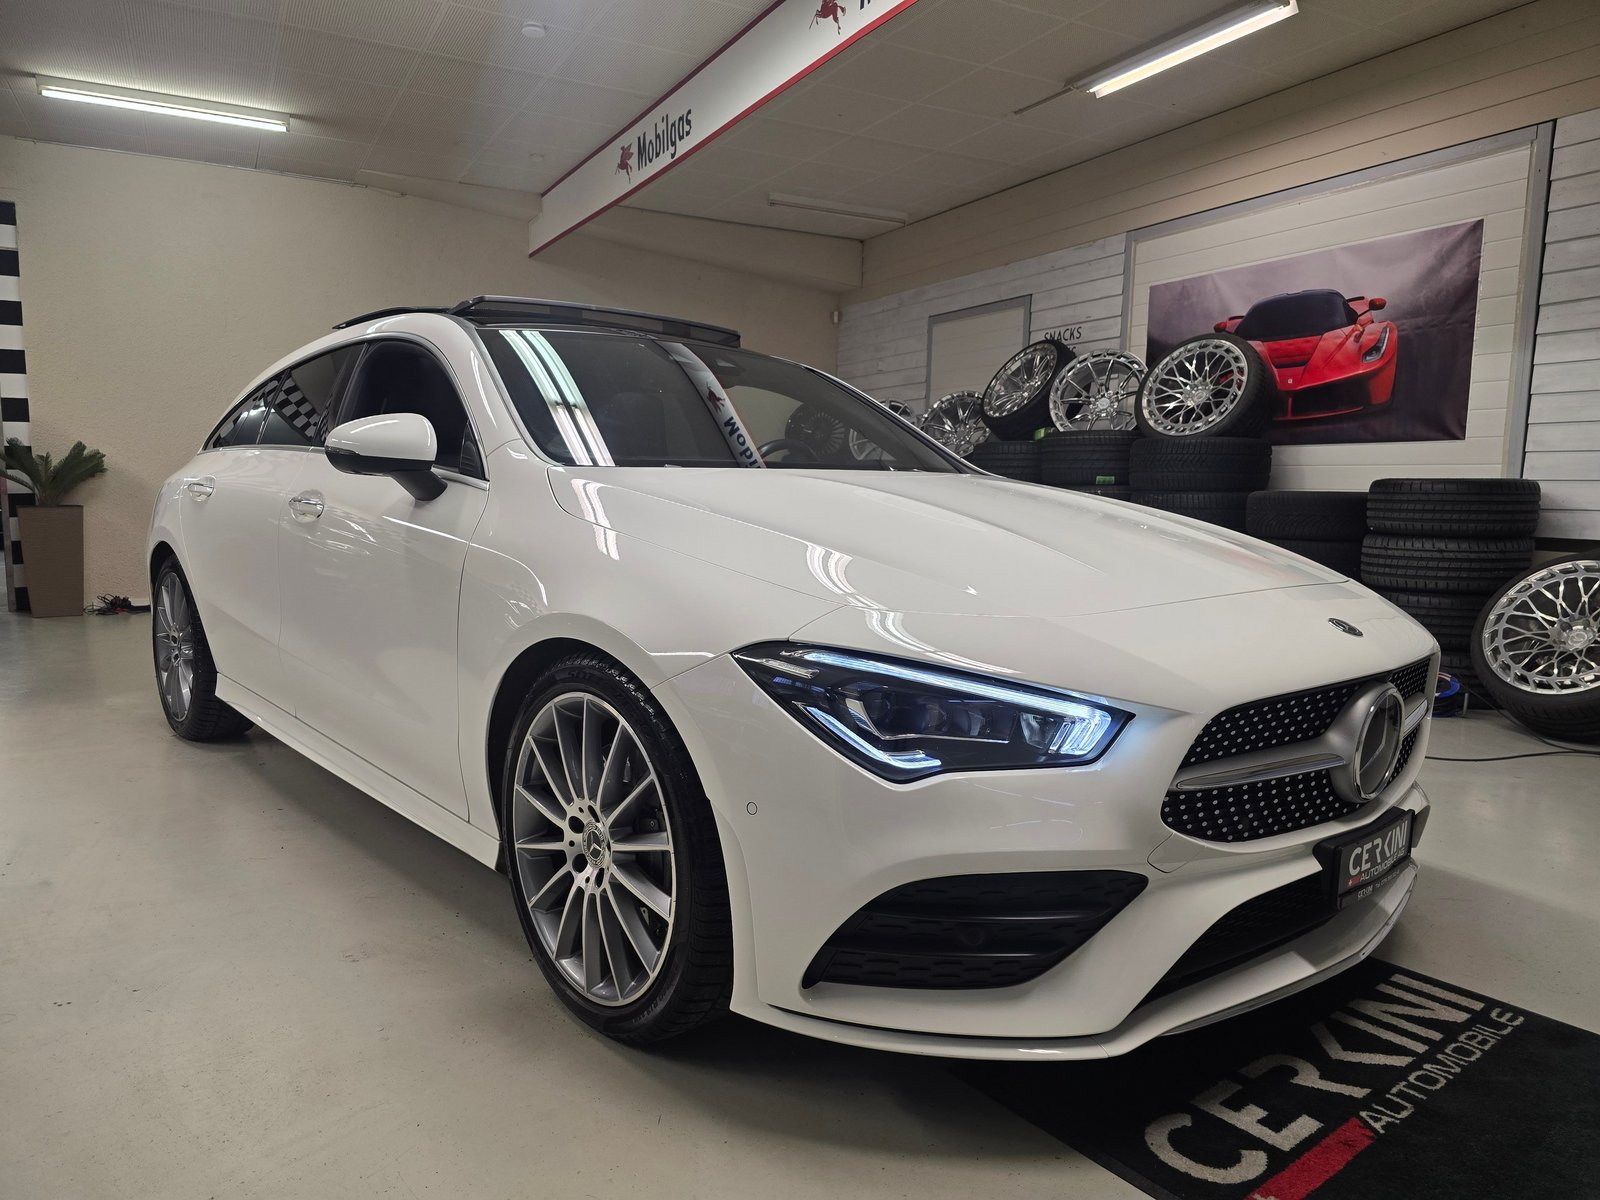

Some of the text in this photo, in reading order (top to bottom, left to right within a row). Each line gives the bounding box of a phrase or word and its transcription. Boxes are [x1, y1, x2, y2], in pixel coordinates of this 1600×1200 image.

[637, 108, 692, 171] Mobilgas
[1044, 326, 1082, 341] SNACKS
[1349, 820, 1408, 876] CERKINI
[1144, 974, 1485, 1184] CERKINI
[1359, 1007, 1525, 1133] AUTOMOBILE
